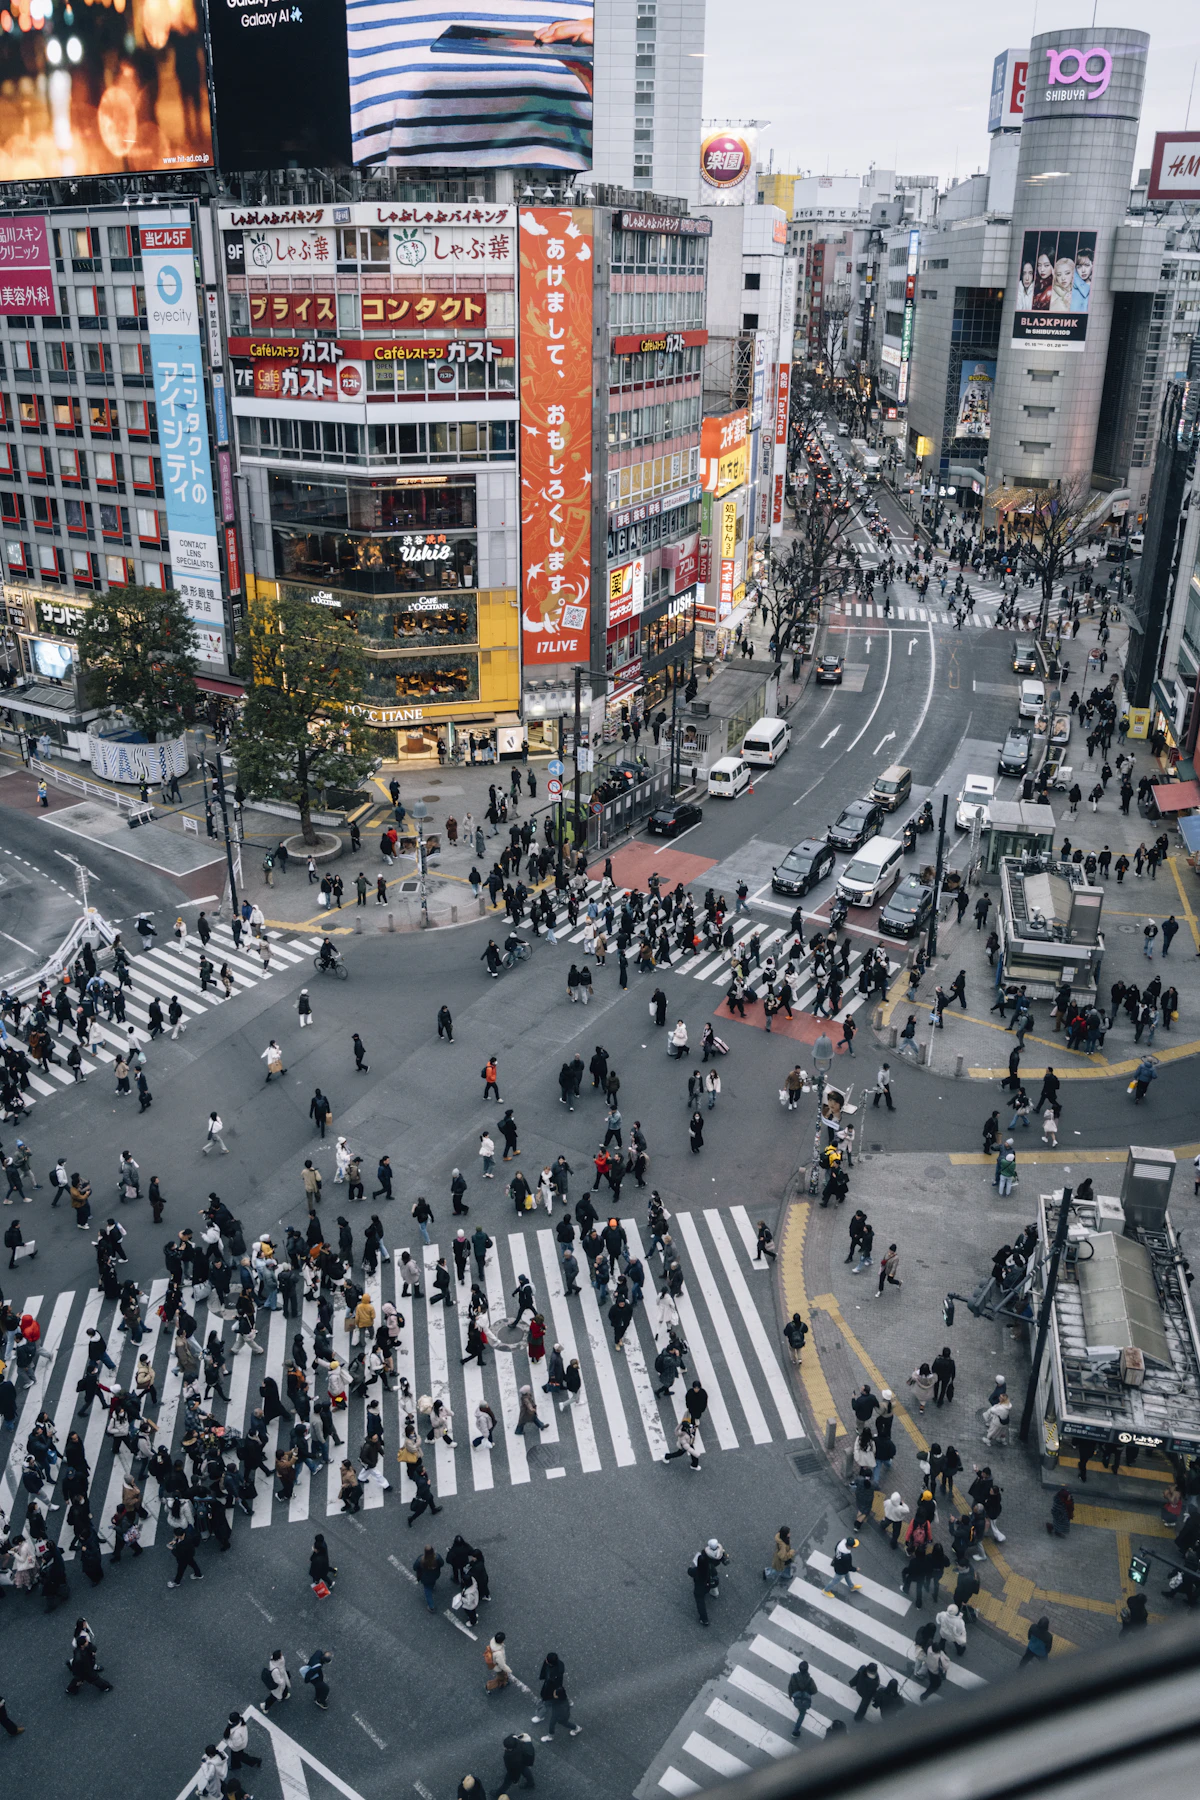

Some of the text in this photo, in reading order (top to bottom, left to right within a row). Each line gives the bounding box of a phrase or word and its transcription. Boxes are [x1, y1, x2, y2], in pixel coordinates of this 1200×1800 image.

[241, 9, 290, 27] Galaxy AI
[1046, 48, 1113, 100] 109
[1045, 89, 1085, 101] SHIBUYA
[162, 153, 209, 164] www.hit-ad.co.jp
[706, 150, 744, 170] 楽園
[1168, 155, 1200, 177] H&M
[231, 208, 325, 226] しゃぶしゃぶバイキング
[377, 208, 509, 224] しゃぶしゃぶバイキング
[145, 230, 187, 247] 当ビル5F
[434, 233, 510, 261] しゃぶ葉
[227, 243, 244, 260] 9F
[276, 235, 330, 262] しゃぶ葉
[0, 286, 50, 307] 美容外科
[153, 308, 192, 326] eyecity
[251, 296, 335, 321] プライス
[363, 296, 484, 321] コンタクト
[1020, 316, 1079, 328] BLACKPINK
[302, 340, 343, 363] ガスト
[448, 340, 502, 363] ガスト
[235, 369, 254, 386] 7F
[257, 369, 280, 383] Café
[281, 366, 333, 397] ガスト
[342, 378, 360, 388] ガスト
[546, 237, 566, 607] あけまして、 おもしろくします。
[157, 362, 189, 502] アイシティ
[182, 363, 207, 505] コンタクトの
[691, 486, 702, 501] 4F
[179, 539, 207, 550] CONTACT
[402, 533, 447, 546] 渋谷焼肉
[186, 549, 202, 558] LENS
[399, 544, 451, 562] Ushi8
[176, 556, 214, 569] SPECIALISTS
[679, 556, 694, 576] アコム
[721, 562, 733, 601] スギ薬局
[187, 598, 212, 612] 专卖店
[668, 592, 692, 619] LUSH
[537, 639, 578, 654] 17LIVE
[1132, 1434, 1163, 1444] しぶちか
